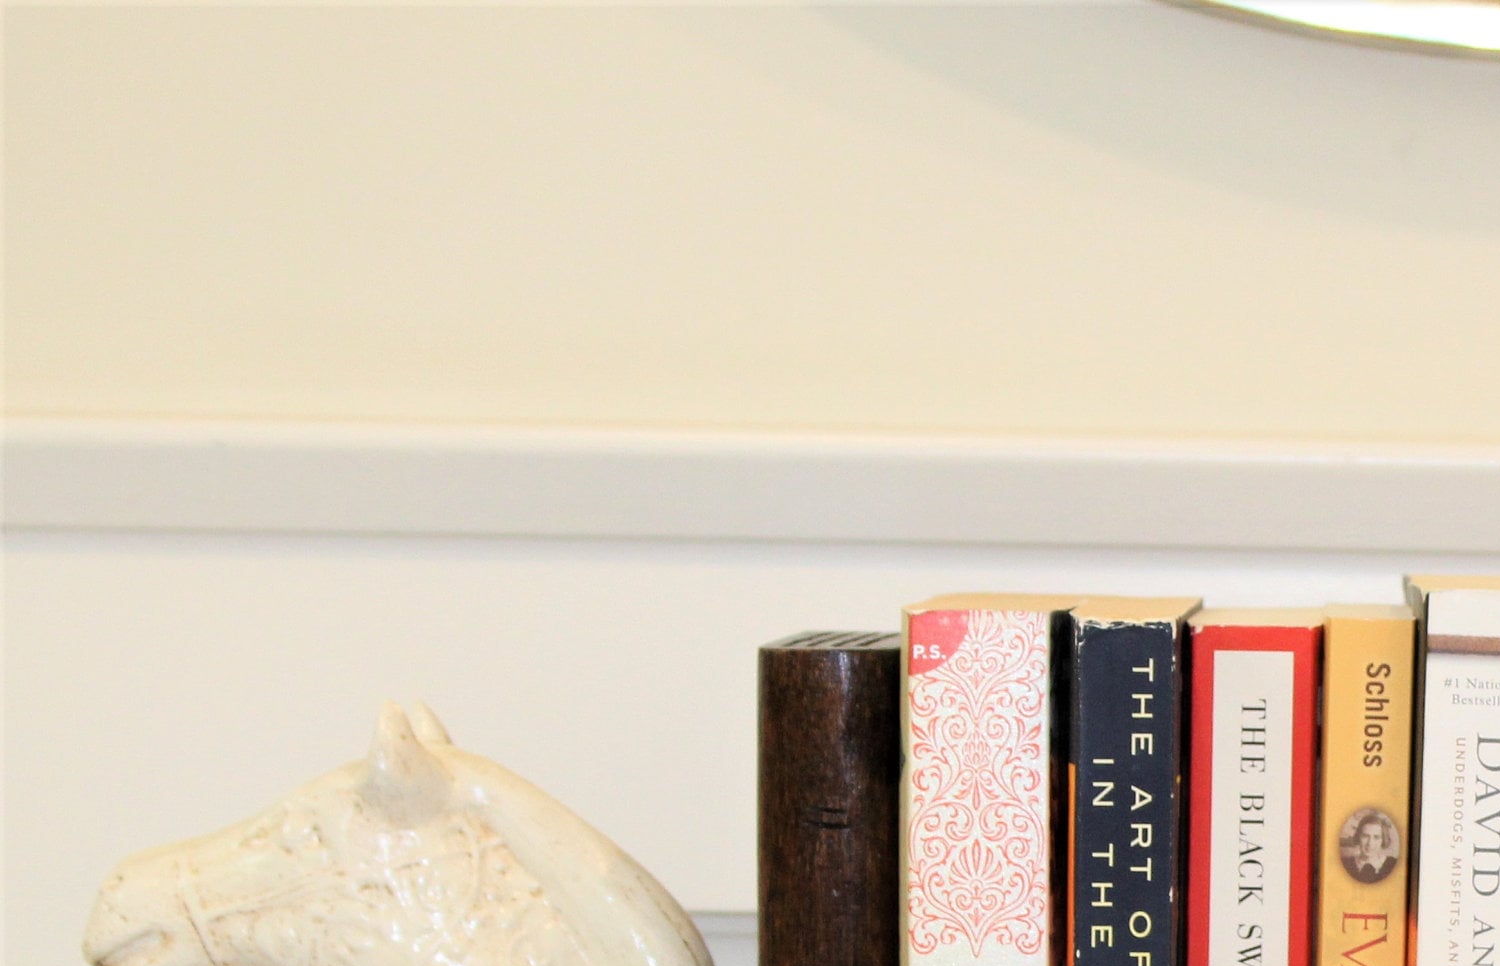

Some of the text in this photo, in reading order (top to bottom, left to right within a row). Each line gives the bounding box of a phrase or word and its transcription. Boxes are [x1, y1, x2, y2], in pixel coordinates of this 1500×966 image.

[913, 644, 947, 660] P.S.
[1444, 678, 1459, 688] #1
[1131, 657, 1155, 756] THE
[1240, 698, 1267, 774] THE
[1363, 662, 1391, 768] Schloss
[1092, 758, 1115, 808] IN
[1450, 736, 1467, 850] UNDERDOGS,
[1129, 784, 1153, 881] ART
[1238, 792, 1266, 905] BLACK
[1091, 844, 1114, 948] THE
[1448, 856, 1463, 934] MISFITS,
